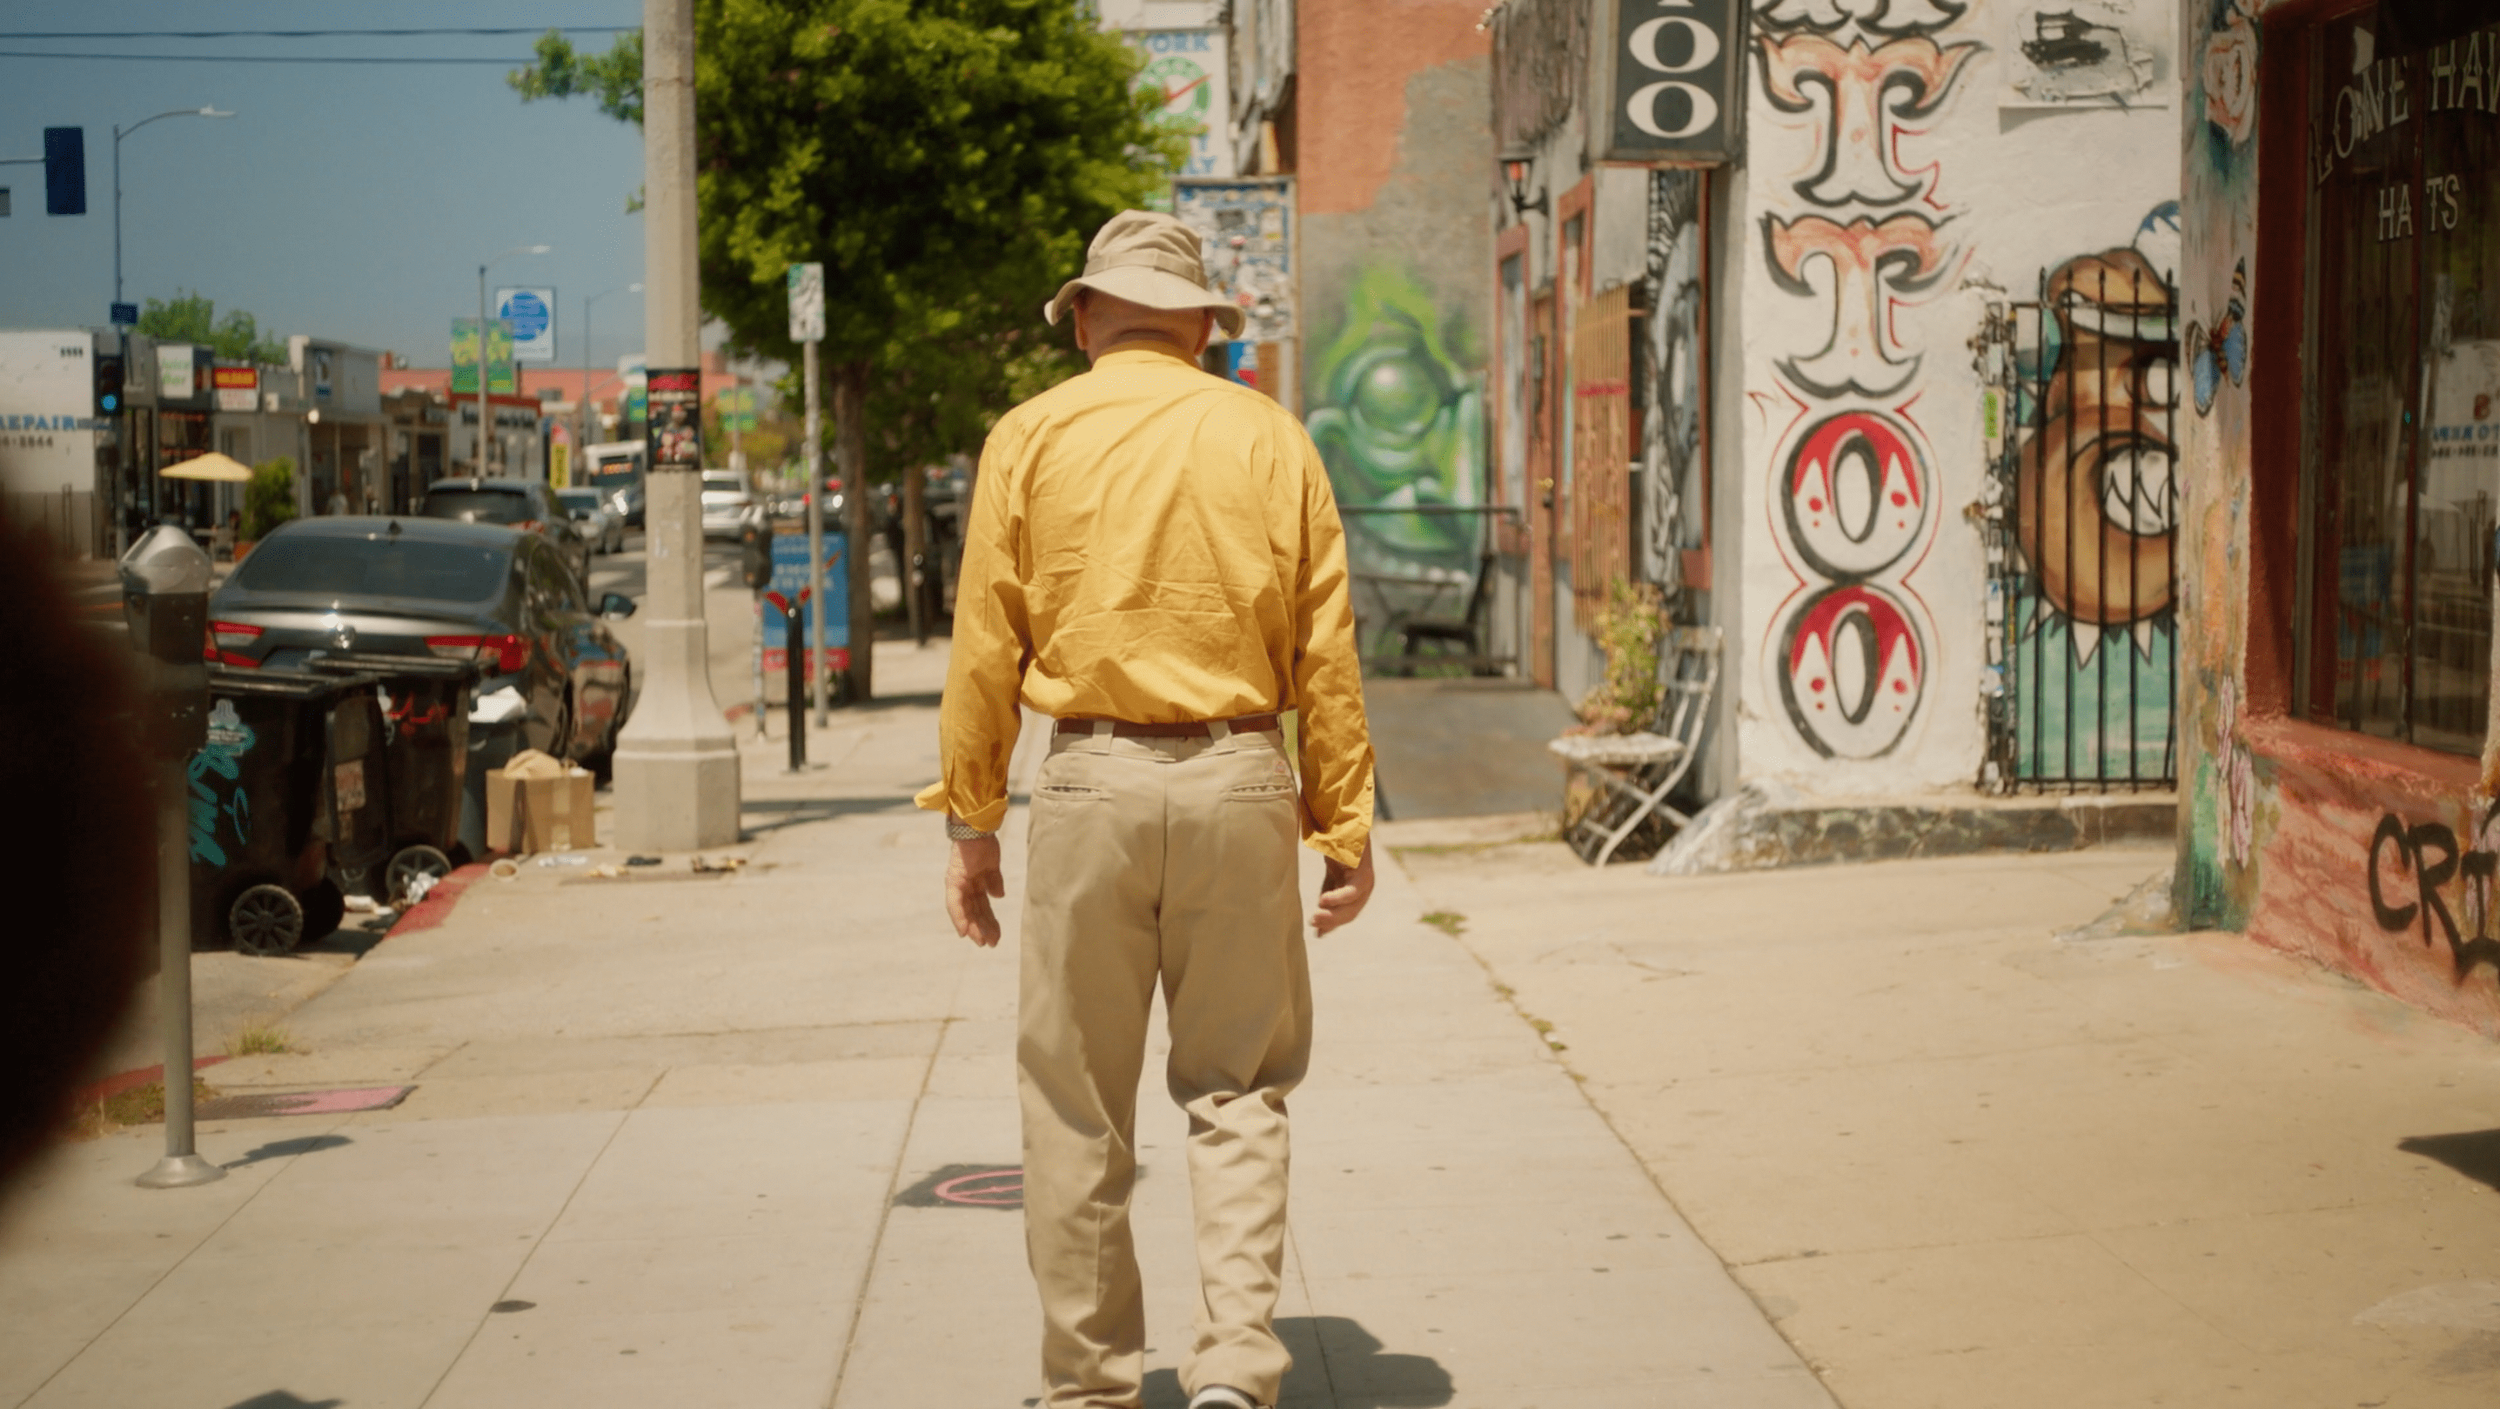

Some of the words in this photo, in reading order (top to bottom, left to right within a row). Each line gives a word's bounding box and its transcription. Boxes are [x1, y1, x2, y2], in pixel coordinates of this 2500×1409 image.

[1143, 32, 1211, 54] ORK
[1627, 0, 1720, 139] OO
[2309, 56, 2409, 187] LONE
[1751, 0, 1990, 759] TTOO
